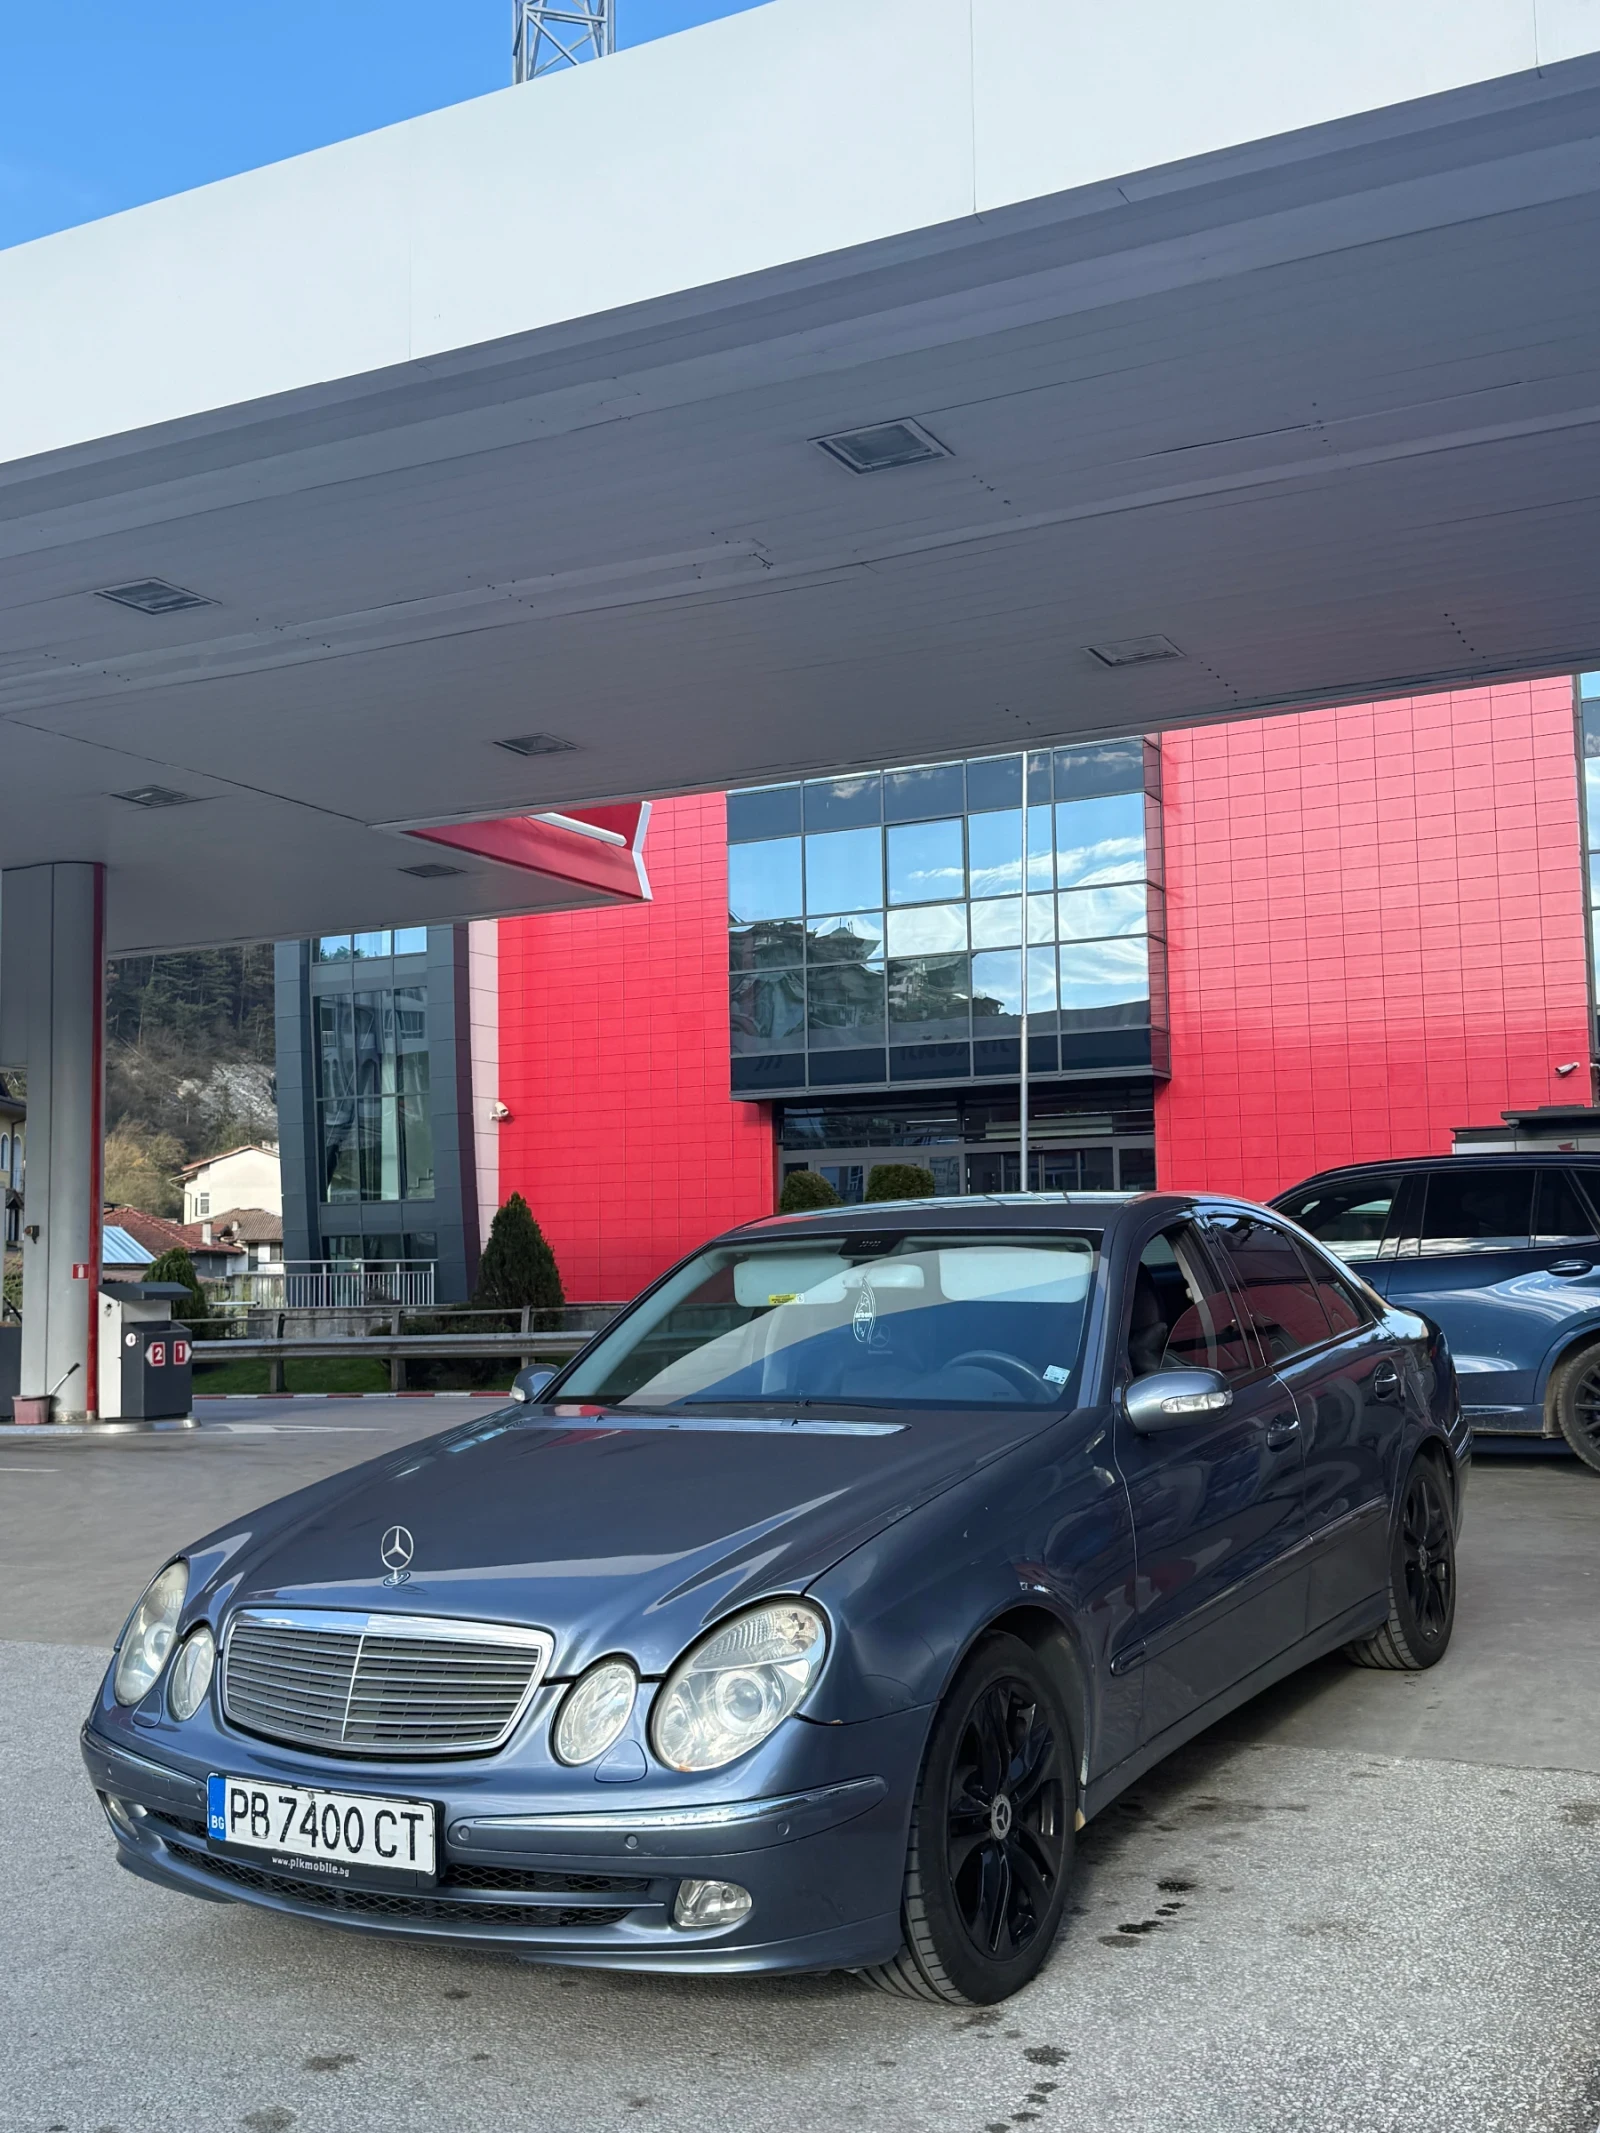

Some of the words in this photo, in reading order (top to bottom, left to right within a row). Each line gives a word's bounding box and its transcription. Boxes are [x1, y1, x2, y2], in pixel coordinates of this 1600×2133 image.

[154, 1346, 163, 1361] 2
[177, 1345, 183, 1359] 1
[211, 1814, 225, 1830] BG
[230, 1787, 270, 1839] PB
[278, 1795, 365, 1853] 7400
[374, 1809, 424, 1861] CT
